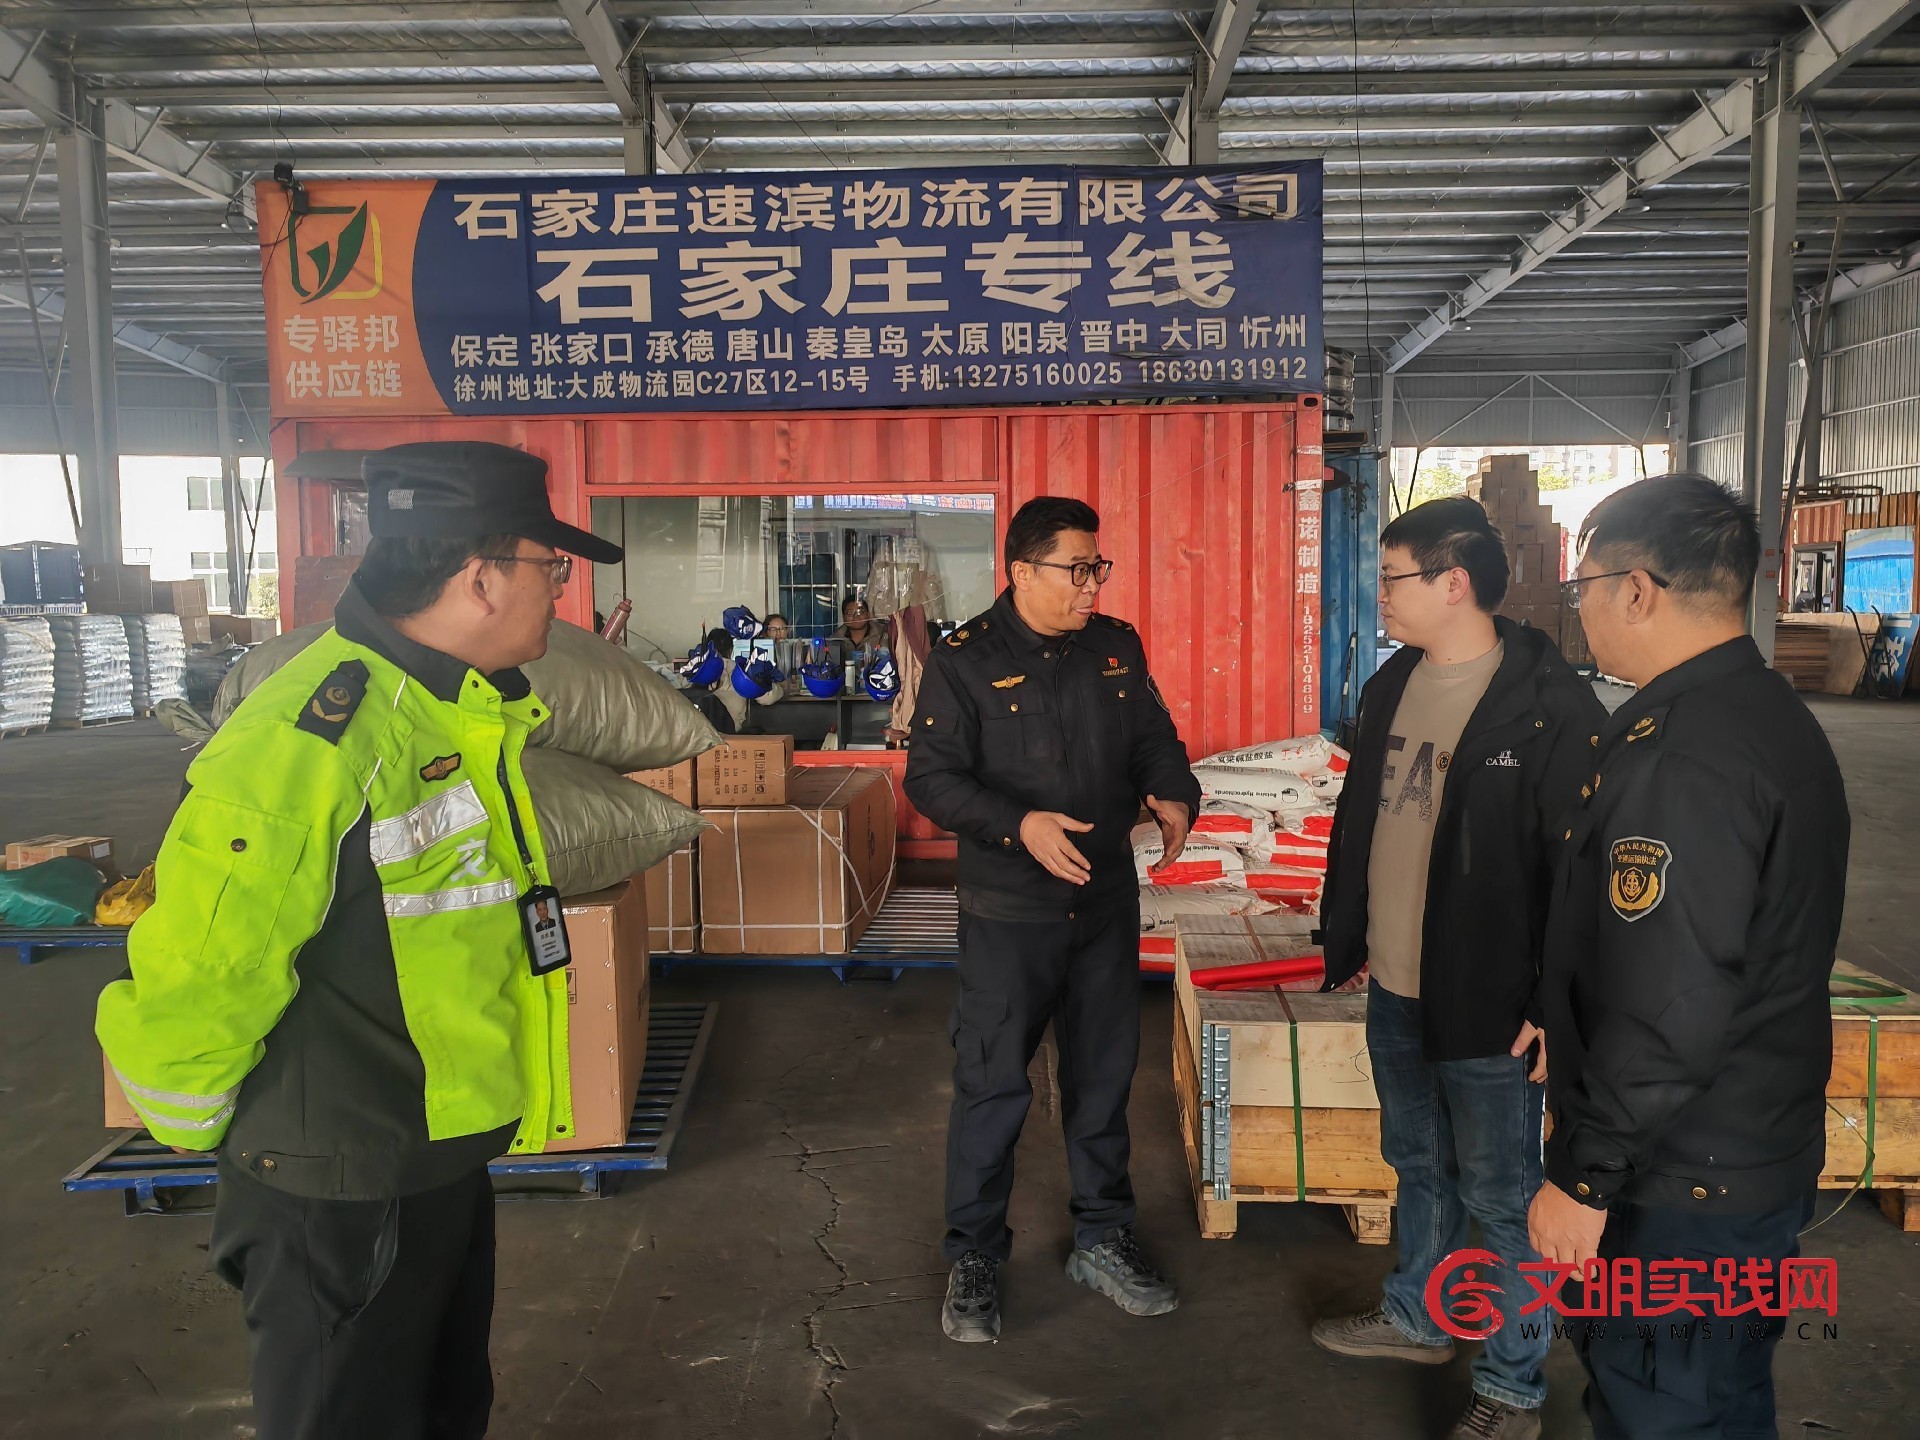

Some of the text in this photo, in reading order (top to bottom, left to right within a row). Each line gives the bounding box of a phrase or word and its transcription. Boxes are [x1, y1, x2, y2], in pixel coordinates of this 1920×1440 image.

[454, 173, 1299, 240] 石家庄速滨物流有限公司
[535, 230, 1236, 325] 石家庄专线
[283, 314, 400, 355] 专驿邦
[451, 314, 1307, 368] 保定 张家口 承德 唐山 秦皇岛 太原 阳泉 晋中 大同 忻州
[285, 359, 402, 399] 供应链
[892, 362, 1122, 394] 手机:13275160025
[1139, 356, 1307, 385] 18630131912
[1297, 487, 1320, 595] 鑫诺制造
[1302, 605, 1313, 714] 18252104869
[1485, 758, 1521, 767] CAMEL
[450, 837, 488, 882] 交
